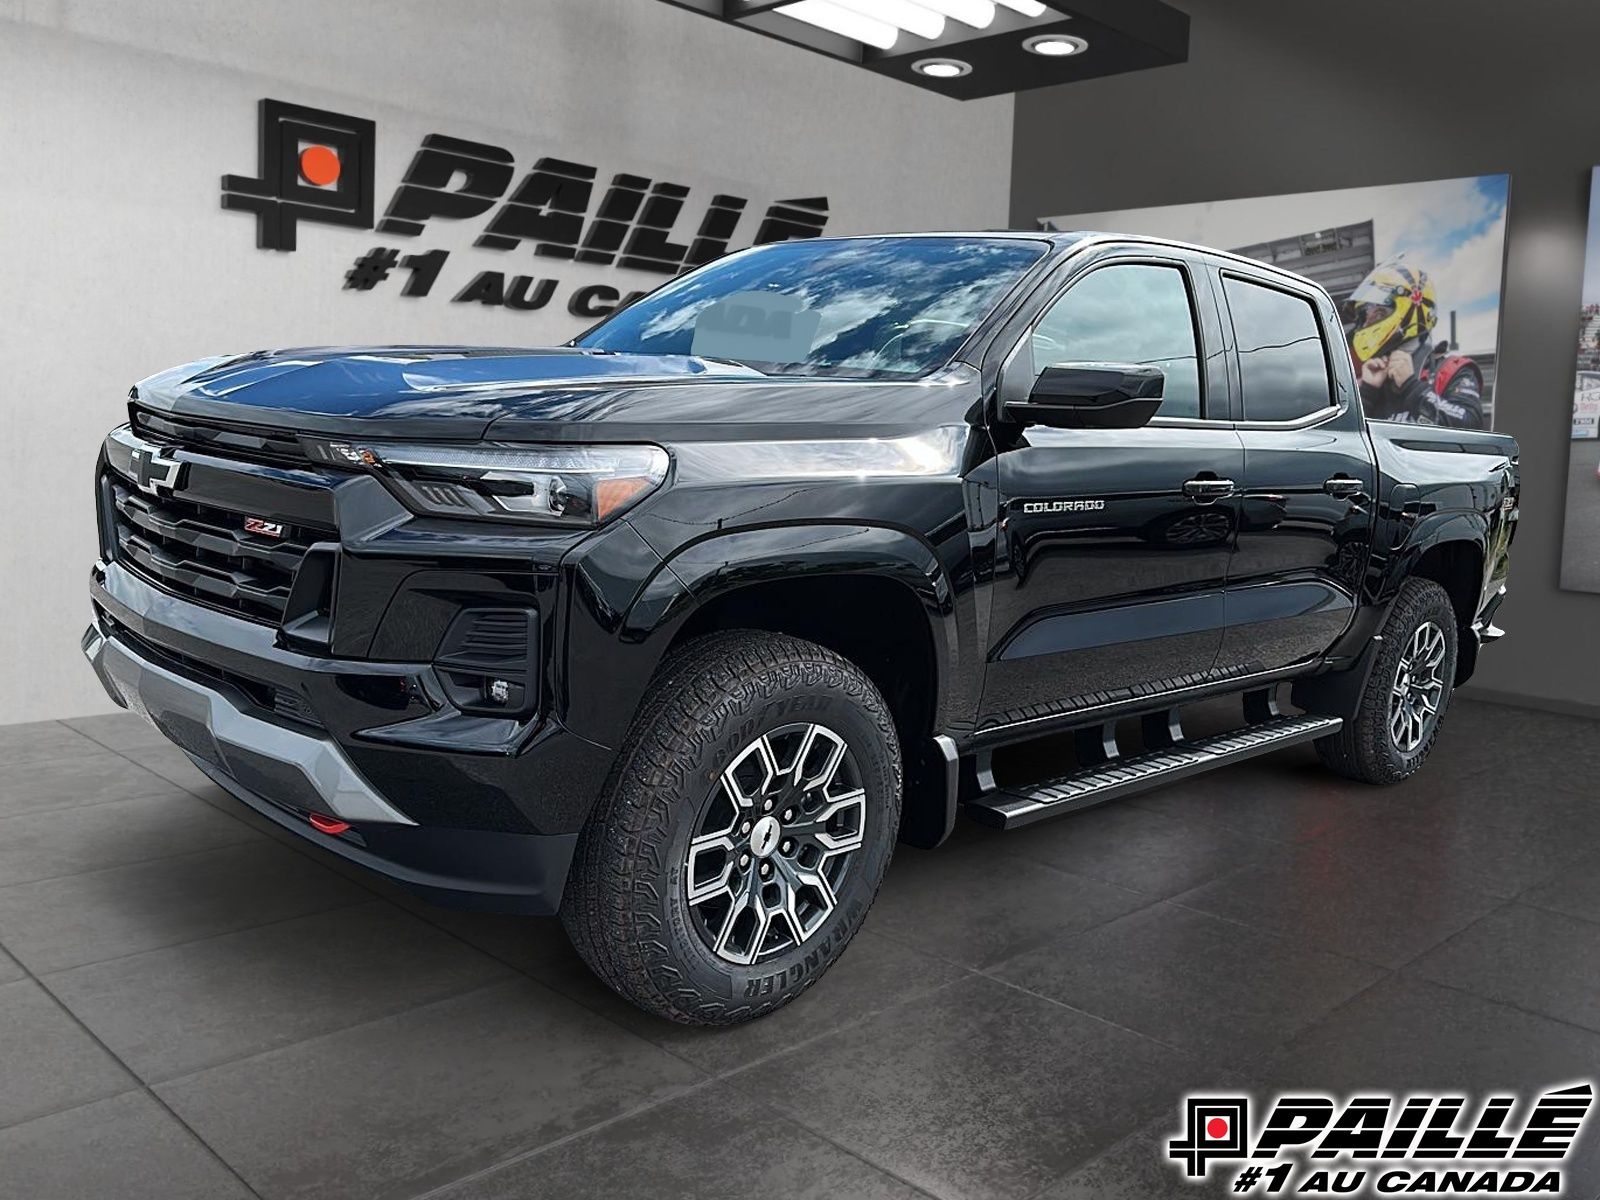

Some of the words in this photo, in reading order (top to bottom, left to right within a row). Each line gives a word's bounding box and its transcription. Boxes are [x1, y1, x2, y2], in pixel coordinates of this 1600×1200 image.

[342, 246, 450, 298] #1
[449, 270, 559, 311] AU
[1023, 499, 1105, 514] COLORADO
